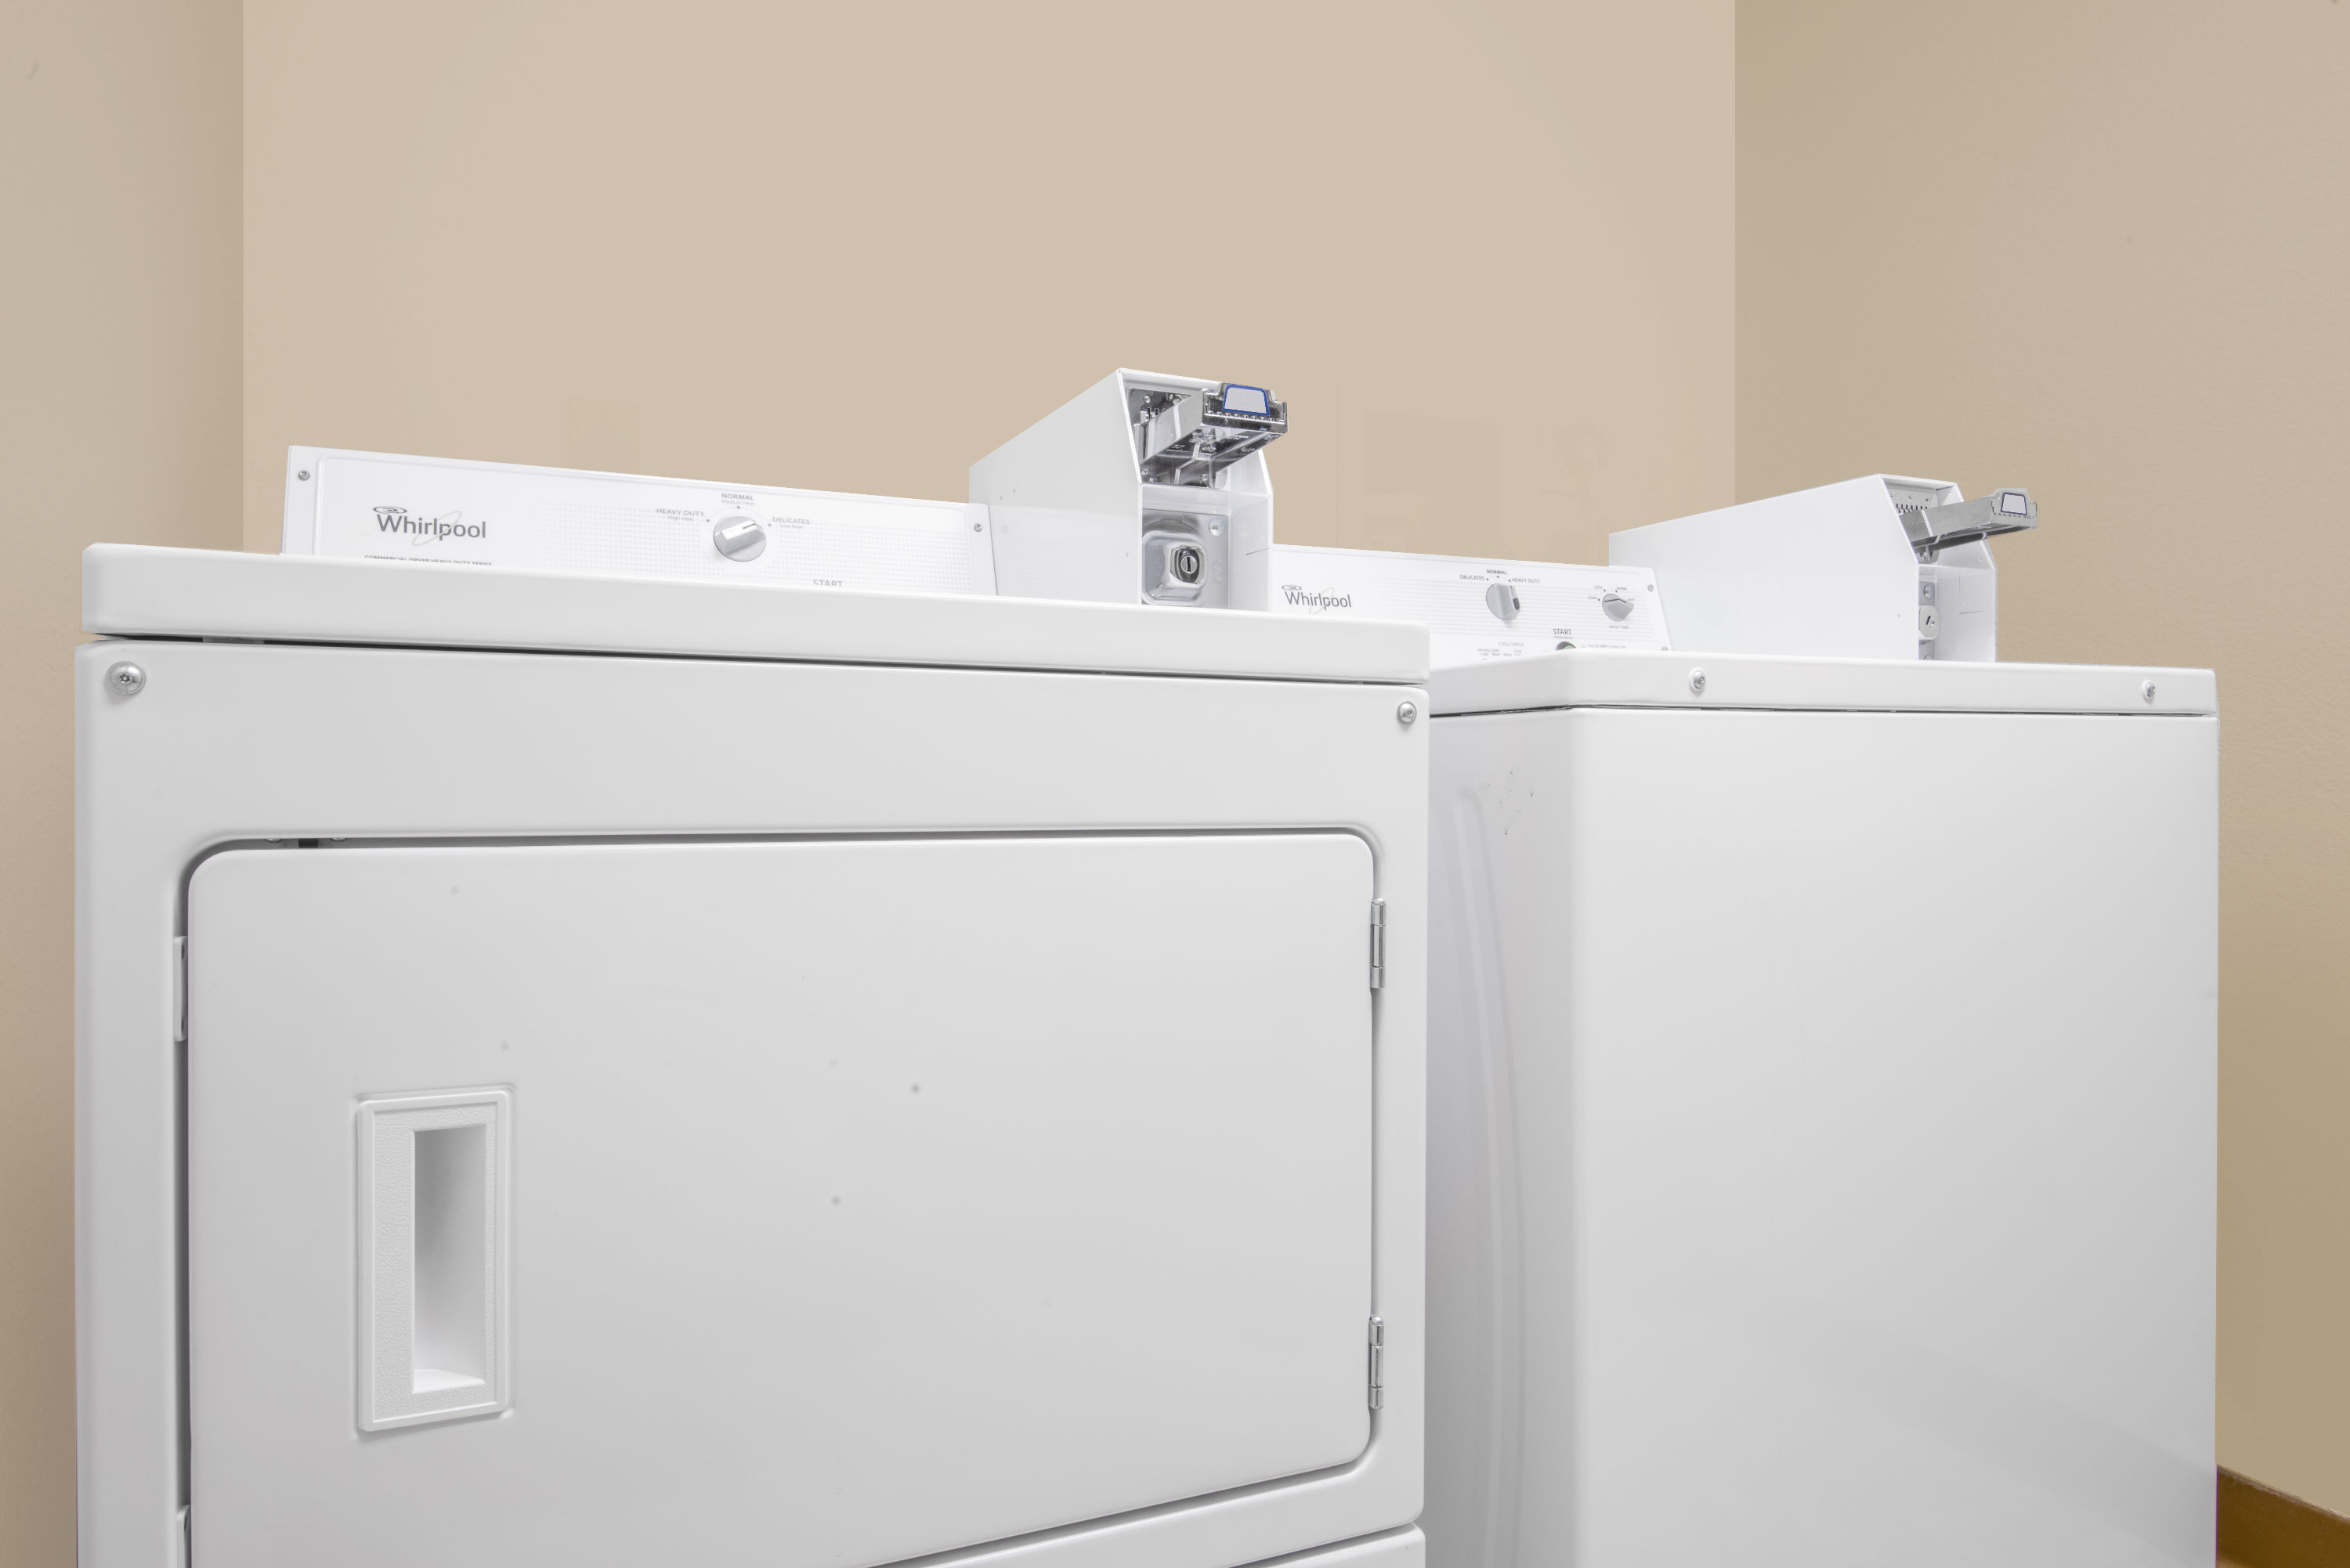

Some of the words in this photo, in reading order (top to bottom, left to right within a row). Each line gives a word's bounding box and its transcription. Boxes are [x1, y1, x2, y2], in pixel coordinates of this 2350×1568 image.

[721, 493, 754, 501] NORMAL
[377, 514, 486, 541] Whirlpool
[772, 516, 810, 525] DELICATES
[1285, 591, 1351, 611] Whirlpool
